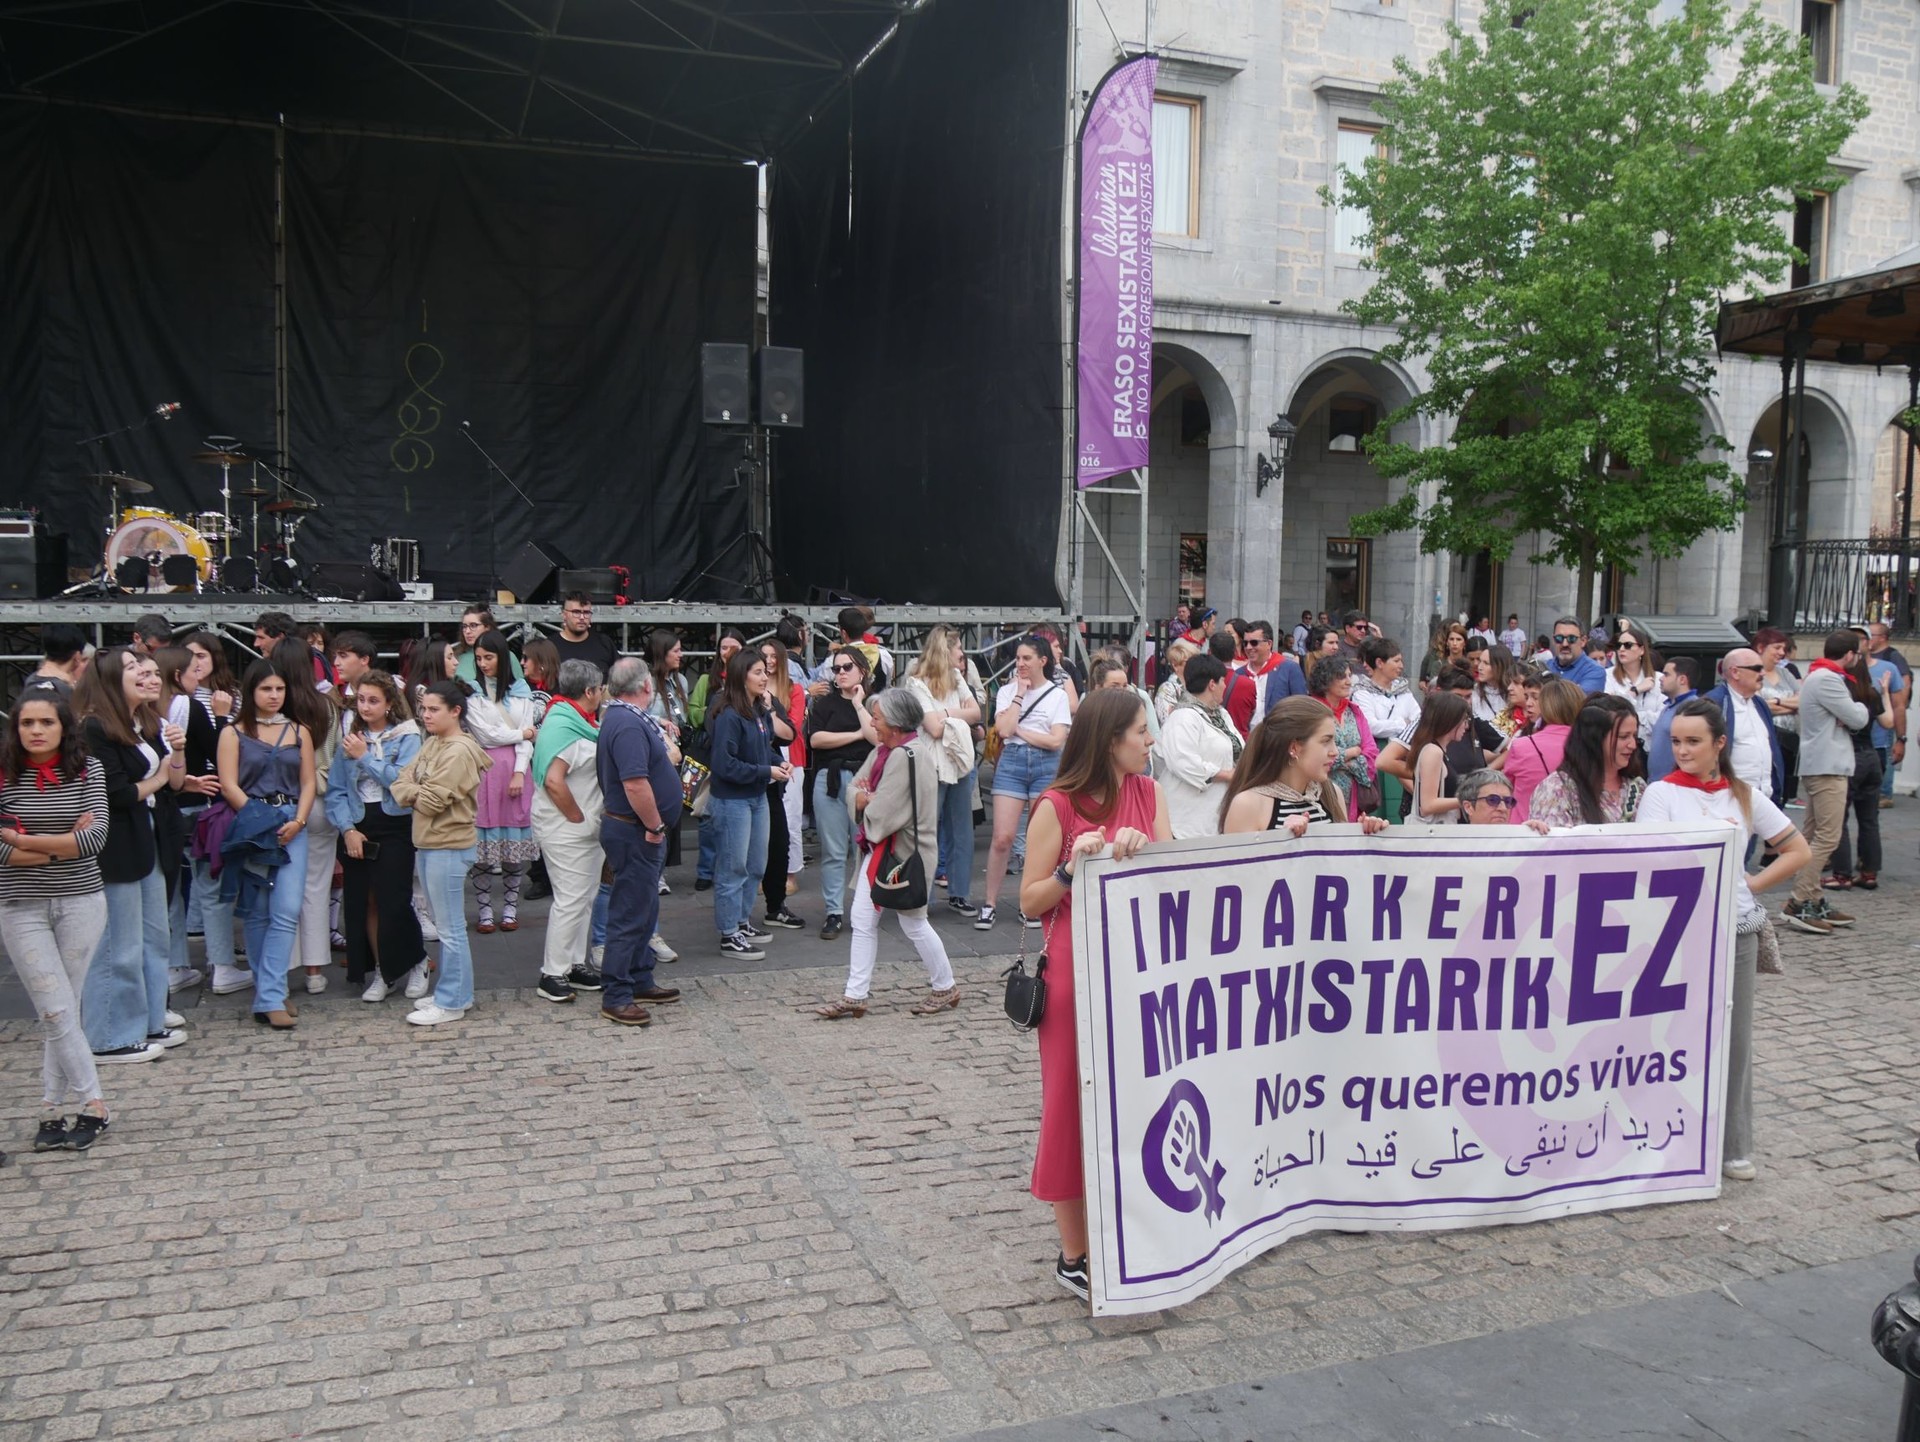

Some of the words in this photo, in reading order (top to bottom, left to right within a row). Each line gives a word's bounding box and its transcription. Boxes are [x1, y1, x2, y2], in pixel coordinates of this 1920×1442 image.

[1118, 162, 1137, 198] EZ!
[1140, 162, 1153, 234] SEXISTAS
[1116, 204, 1138, 349] SEXISTARIK
[1140, 237, 1153, 339] AGRESIONES
[1138, 373, 1149, 385] A
[1139, 341, 1151, 370] LAS
[1113, 354, 1135, 437] ERASO
[1136, 387, 1149, 413] NO
[1080, 456, 1101, 467] 016
[1130, 874, 1556, 973] INDARKERI
[1566, 866, 1706, 1026] EZ
[1140, 957, 1555, 1078] MATXISTARIK
[1255, 1073, 1326, 1127] Nos
[1341, 1064, 1580, 1122] queremos
[1589, 1045, 1687, 1092] vivas
[1253, 1127, 1325, 1188] الحياة
[1346, 1129, 1397, 1180] قيد
[1411, 1126, 1485, 1180] على
[1504, 1121, 1567, 1177] نبقى
[1575, 1101, 1610, 1160] أن
[1622, 1106, 1685, 1152] نريد
